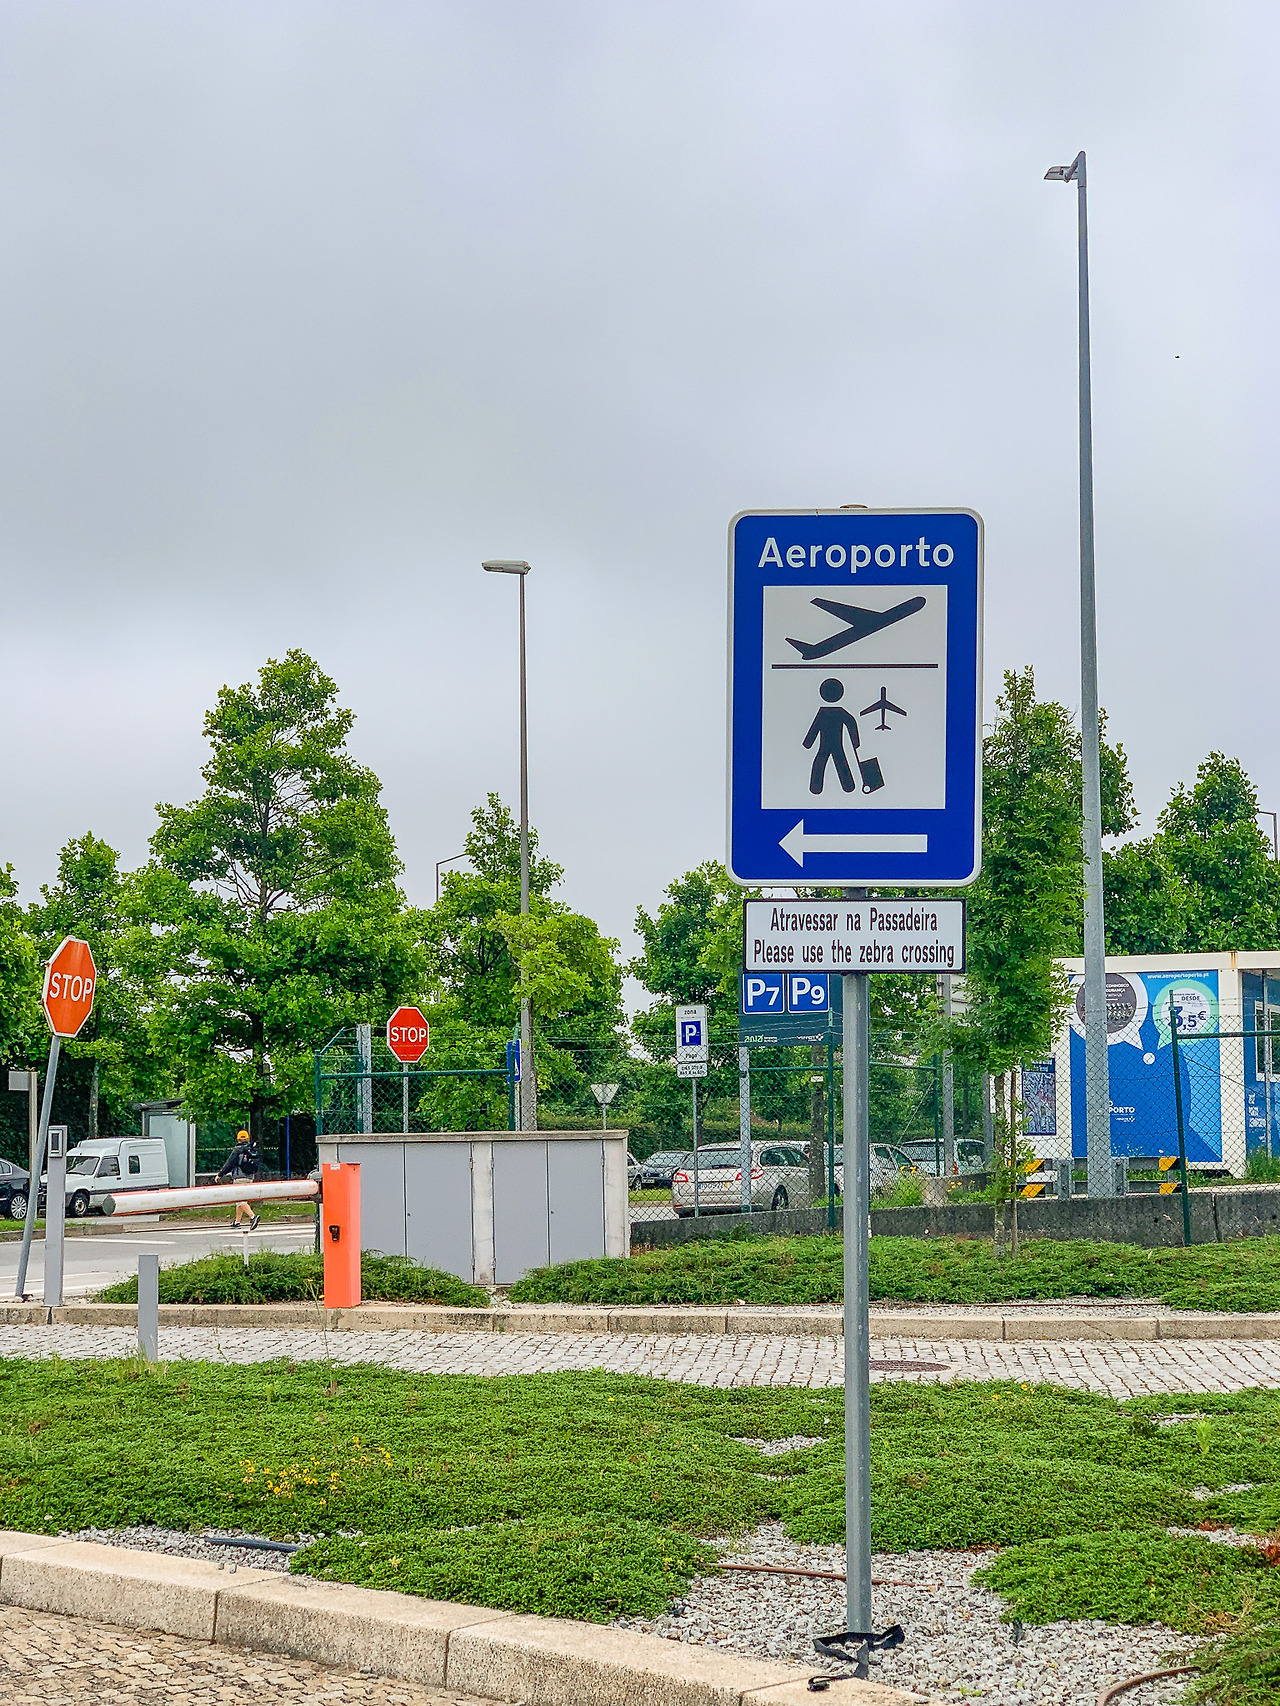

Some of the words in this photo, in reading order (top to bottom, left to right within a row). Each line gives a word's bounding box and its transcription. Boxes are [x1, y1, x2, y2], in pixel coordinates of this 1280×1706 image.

[758, 537, 954, 574] Aeroporto
[770, 907, 838, 931] Atravessar
[846, 913, 861, 931] na
[870, 907, 938, 931] Passadeira
[753, 939, 794, 963] Please
[802, 944, 824, 963] use
[832, 940, 851, 963] the
[859, 940, 894, 963] zebra
[901, 940, 955, 967] crossing
[49, 972, 93, 1003] STOP
[747, 978, 780, 1007] P7
[792, 977, 825, 1006] P9
[391, 1026, 427, 1043] STOP
